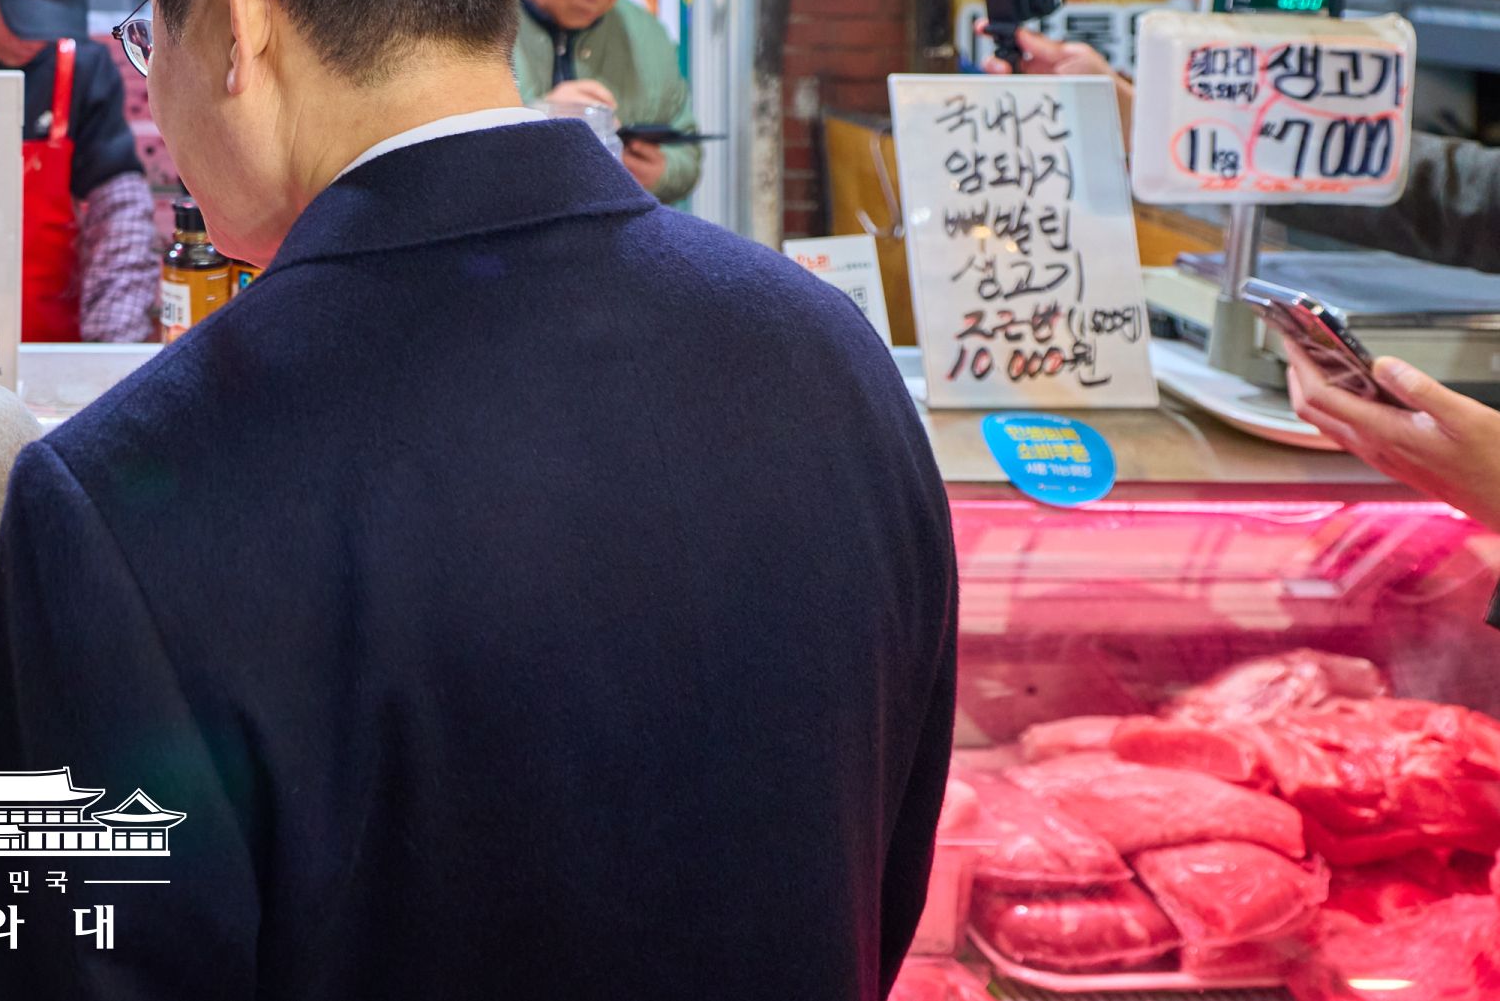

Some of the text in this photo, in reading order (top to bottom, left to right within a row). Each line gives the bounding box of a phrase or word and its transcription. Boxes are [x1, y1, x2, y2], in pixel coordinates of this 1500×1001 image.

[1266, 44, 1402, 108] 생고기
[936, 90, 1072, 148] 국내산
[944, 145, 1075, 201] 암돼지
[951, 250, 1085, 302] 생고기
